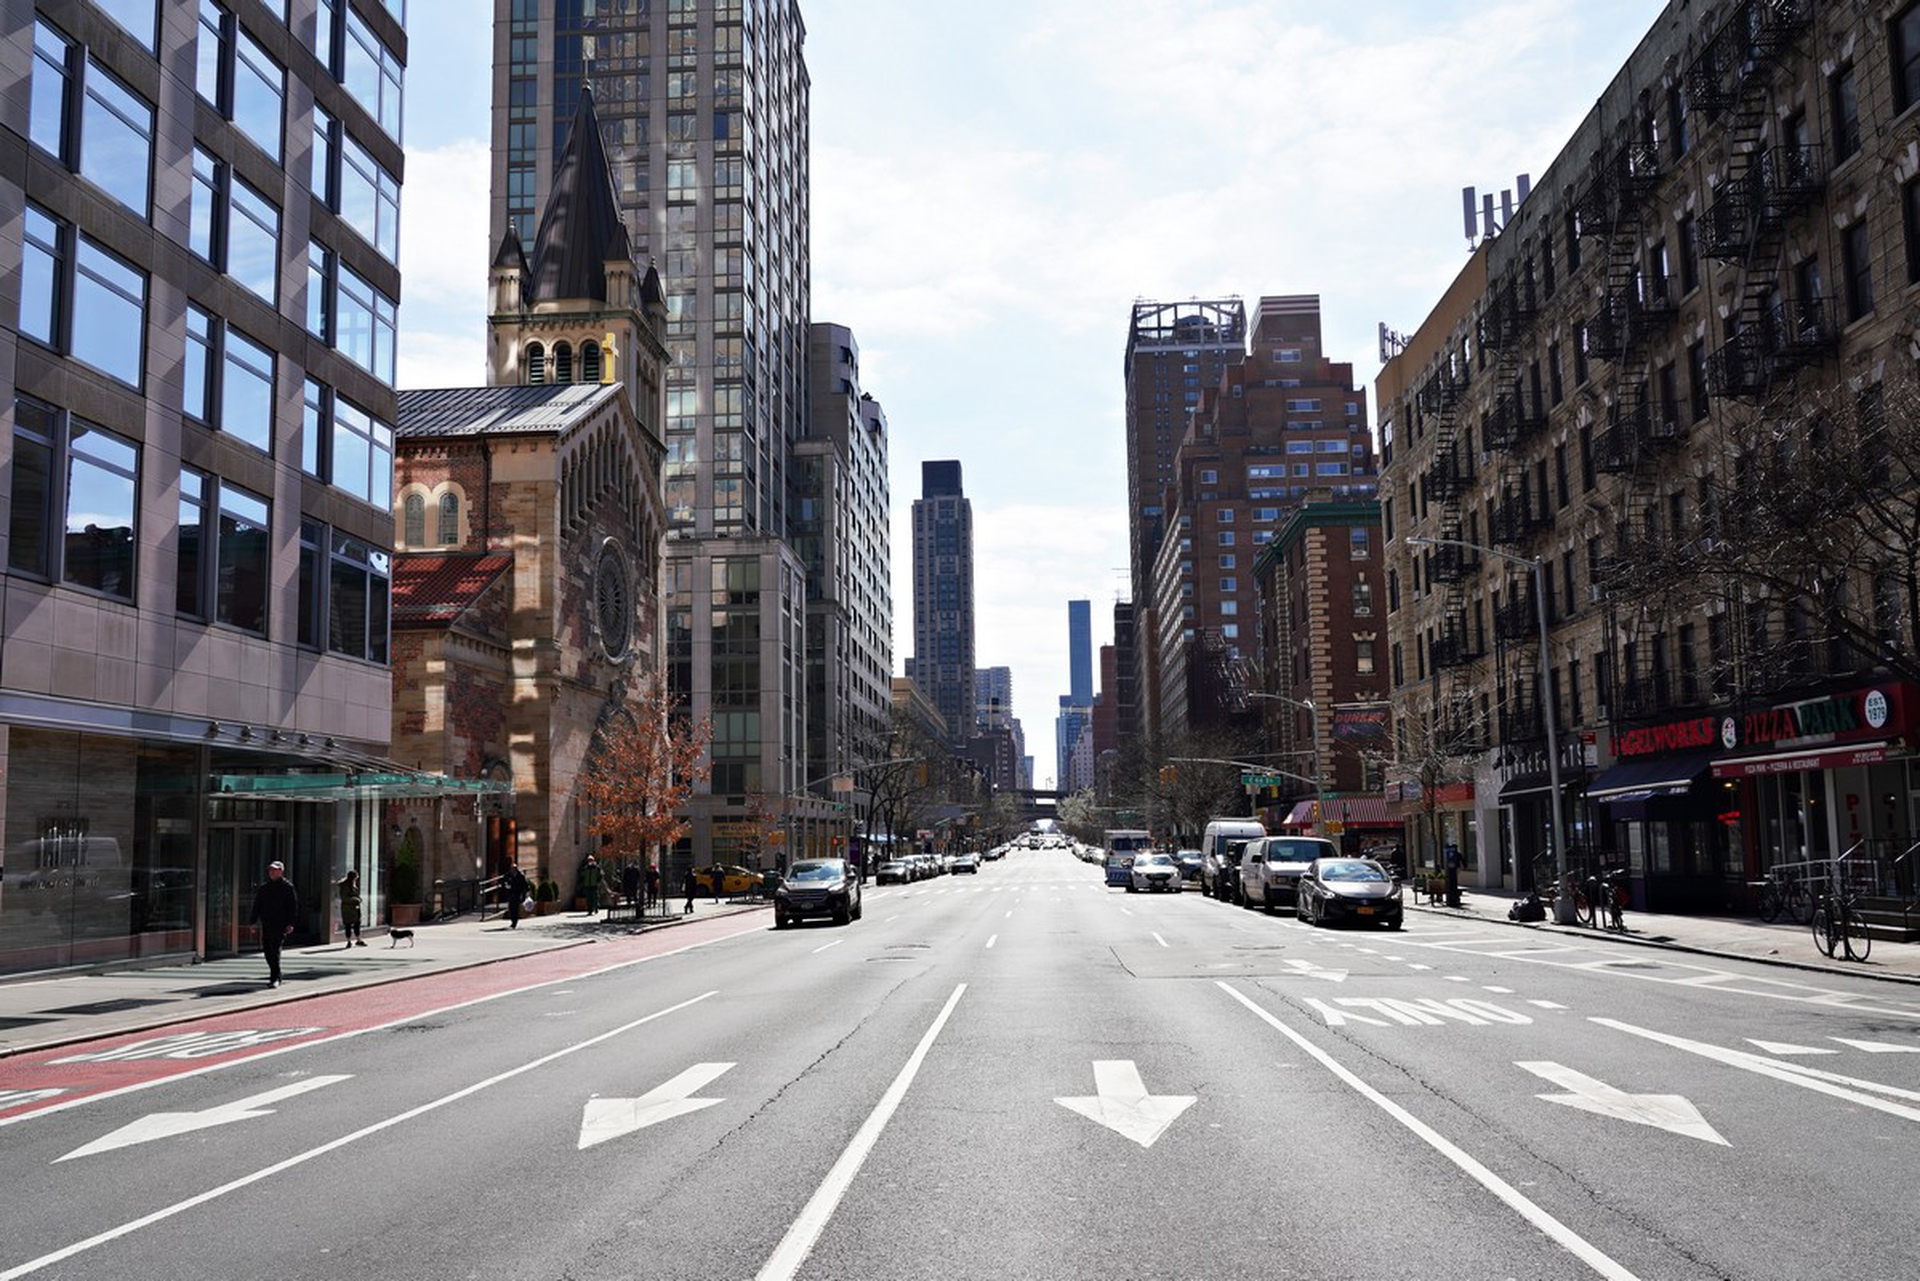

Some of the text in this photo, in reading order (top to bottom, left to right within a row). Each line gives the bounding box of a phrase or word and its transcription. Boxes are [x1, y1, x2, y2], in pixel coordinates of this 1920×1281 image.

[1744, 698, 1855, 744] PIZZA PARK
[1868, 706, 1886, 721] 1979
[1302, 998, 1533, 1026] ONLY
